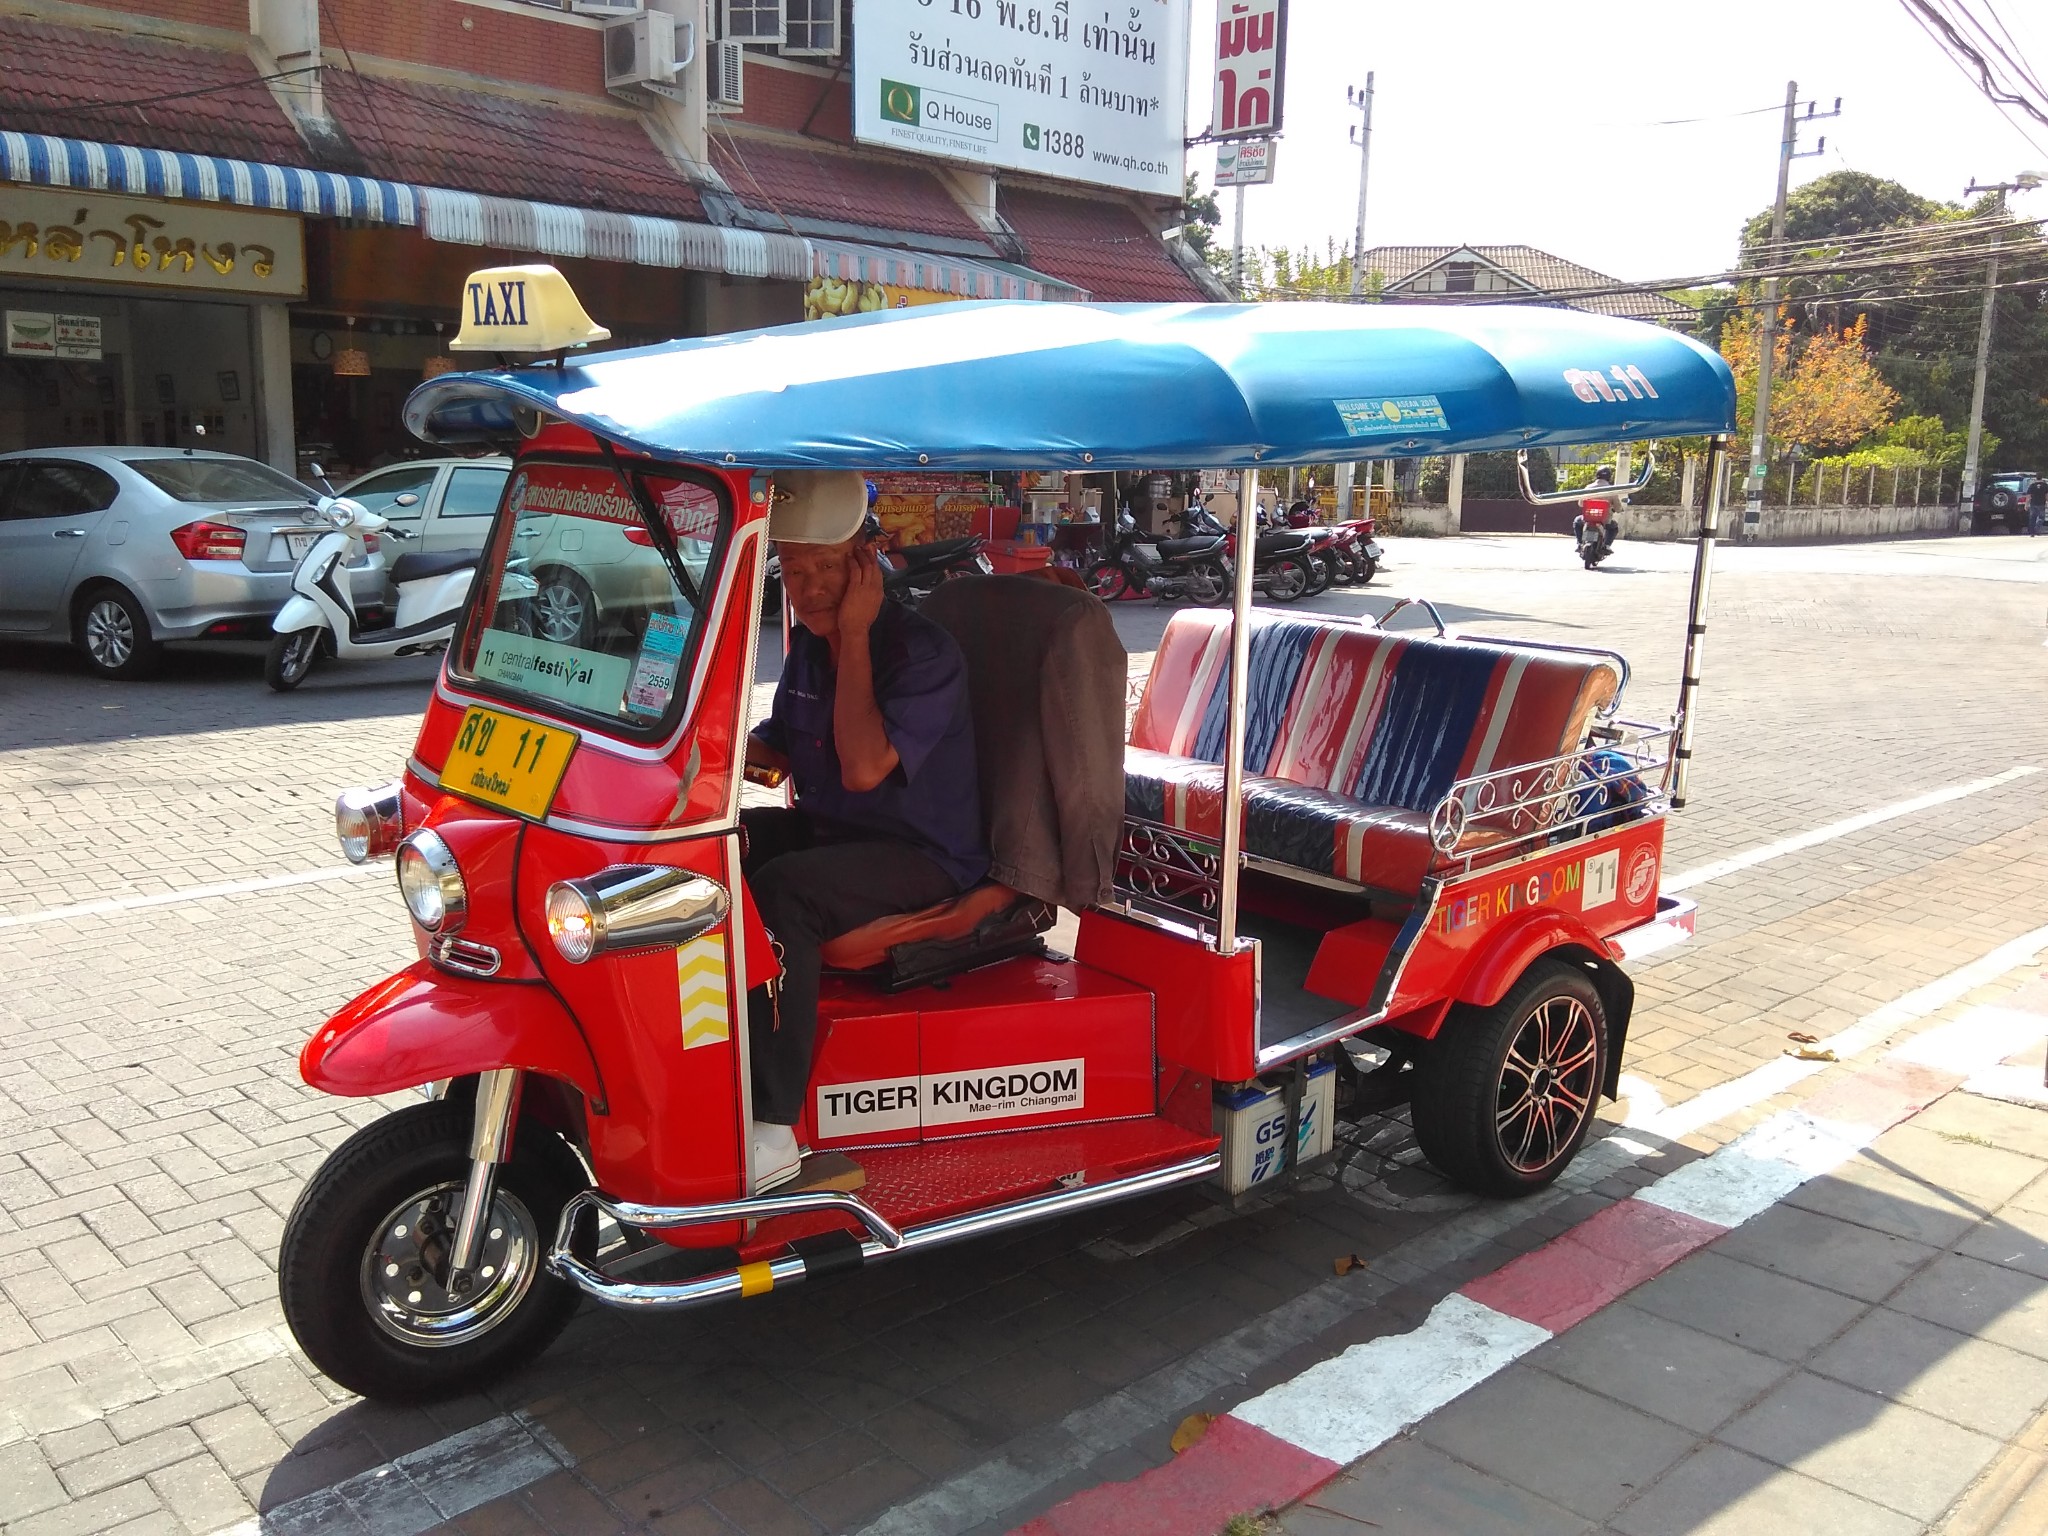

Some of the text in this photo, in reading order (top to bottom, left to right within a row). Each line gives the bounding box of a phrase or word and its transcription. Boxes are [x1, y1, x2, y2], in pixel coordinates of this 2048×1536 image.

[1083, 6, 1155, 65] เท่านั้น
[908, 30, 1052, 96] รับส่วนลดทันที
[1059, 75, 1069, 100] 1
[1219, 68, 1271, 131] ไก่
[926, 100, 992, 131] Q House
[891, 127, 915, 140] FINEST
[949, 138, 972, 151] FINEST
[973, 144, 988, 155] LIFE
[1043, 128, 1084, 159] 1388
[1092, 150, 1169, 175] www.qh.co.th
[468, 281, 528, 326] TAXI
[1337, 400, 1370, 411] WELCOME
[1370, 401, 1380, 410] TO
[1396, 399, 1420, 408] ASEAN
[483, 649, 495, 667] 11
[501, 651, 594, 687] centralfestival
[647, 674, 670, 691] 2559
[458, 711, 547, 774] สข 11
[470, 767, 513, 797] เชียงใหม่
[1595, 857, 1617, 895] 11
[1435, 860, 1581, 937] TIGER KINGDOM
[824, 1067, 1078, 1117] TIGER KINGDOM
[969, 1093, 1078, 1113] Mae-rim Chiangmai
[1256, 1114, 1286, 1145] GS
